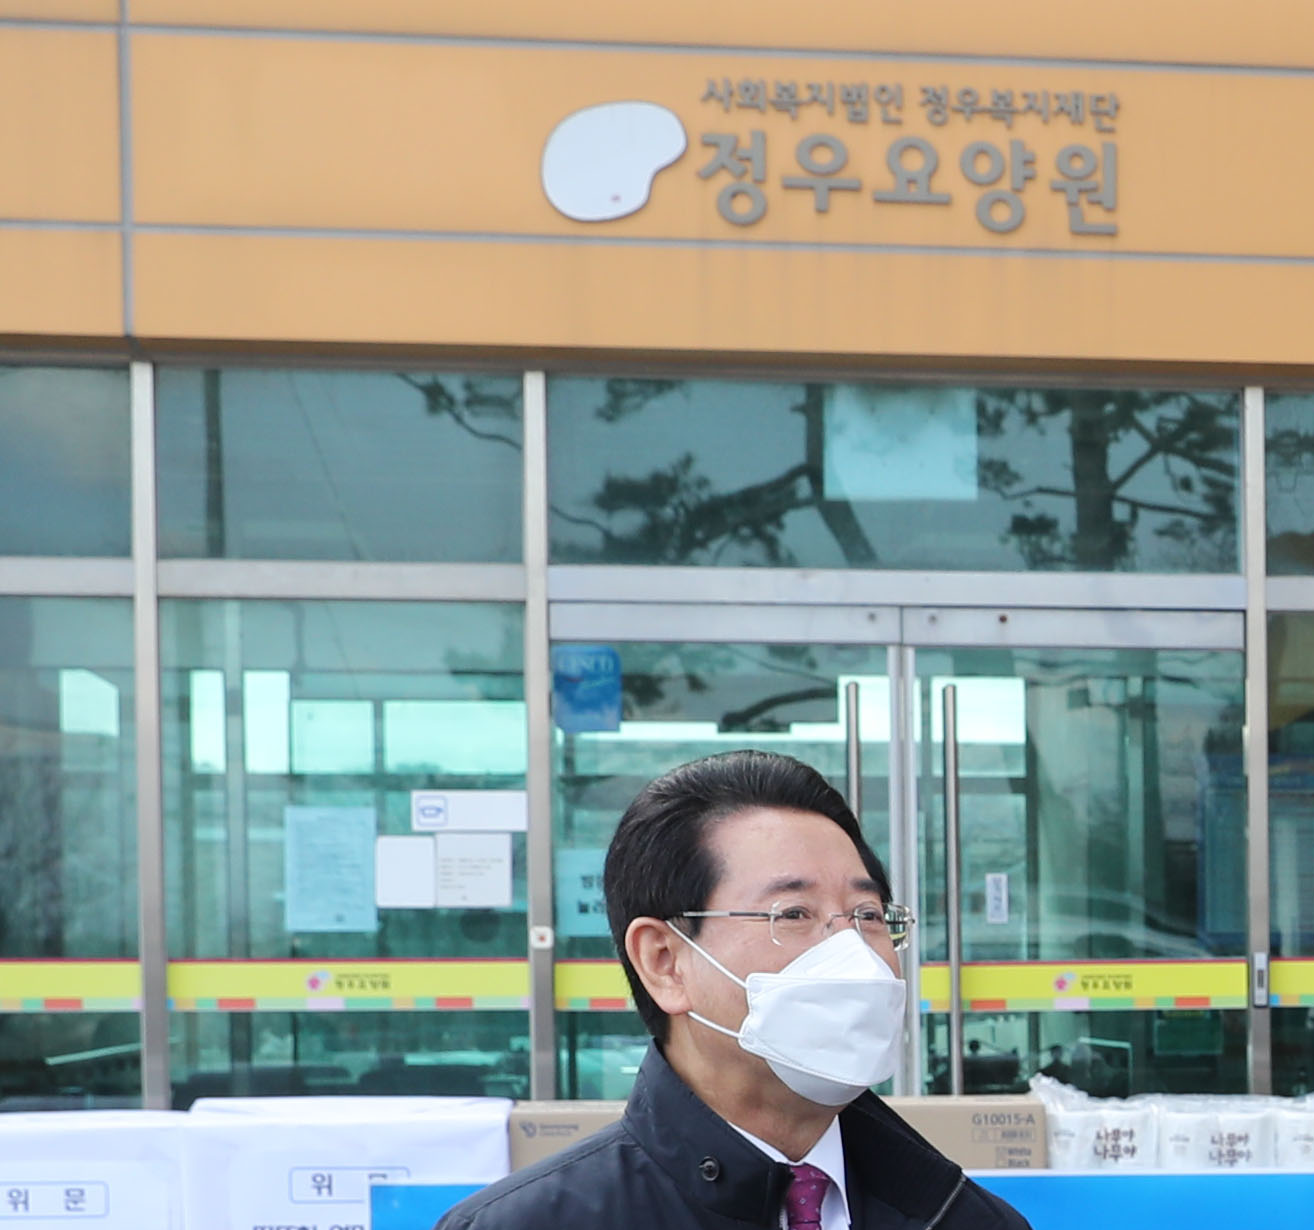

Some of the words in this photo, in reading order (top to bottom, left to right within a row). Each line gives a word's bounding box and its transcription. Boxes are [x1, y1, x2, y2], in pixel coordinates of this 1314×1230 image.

[700, 77, 904, 124] 사회복지법인
[919, 85, 1120, 132] 정우복지재단
[698, 130, 1118, 236] 정우요양원
[971, 1112, 1036, 1126] G10015-A
[1093, 1144, 1137, 1163] 나무야
